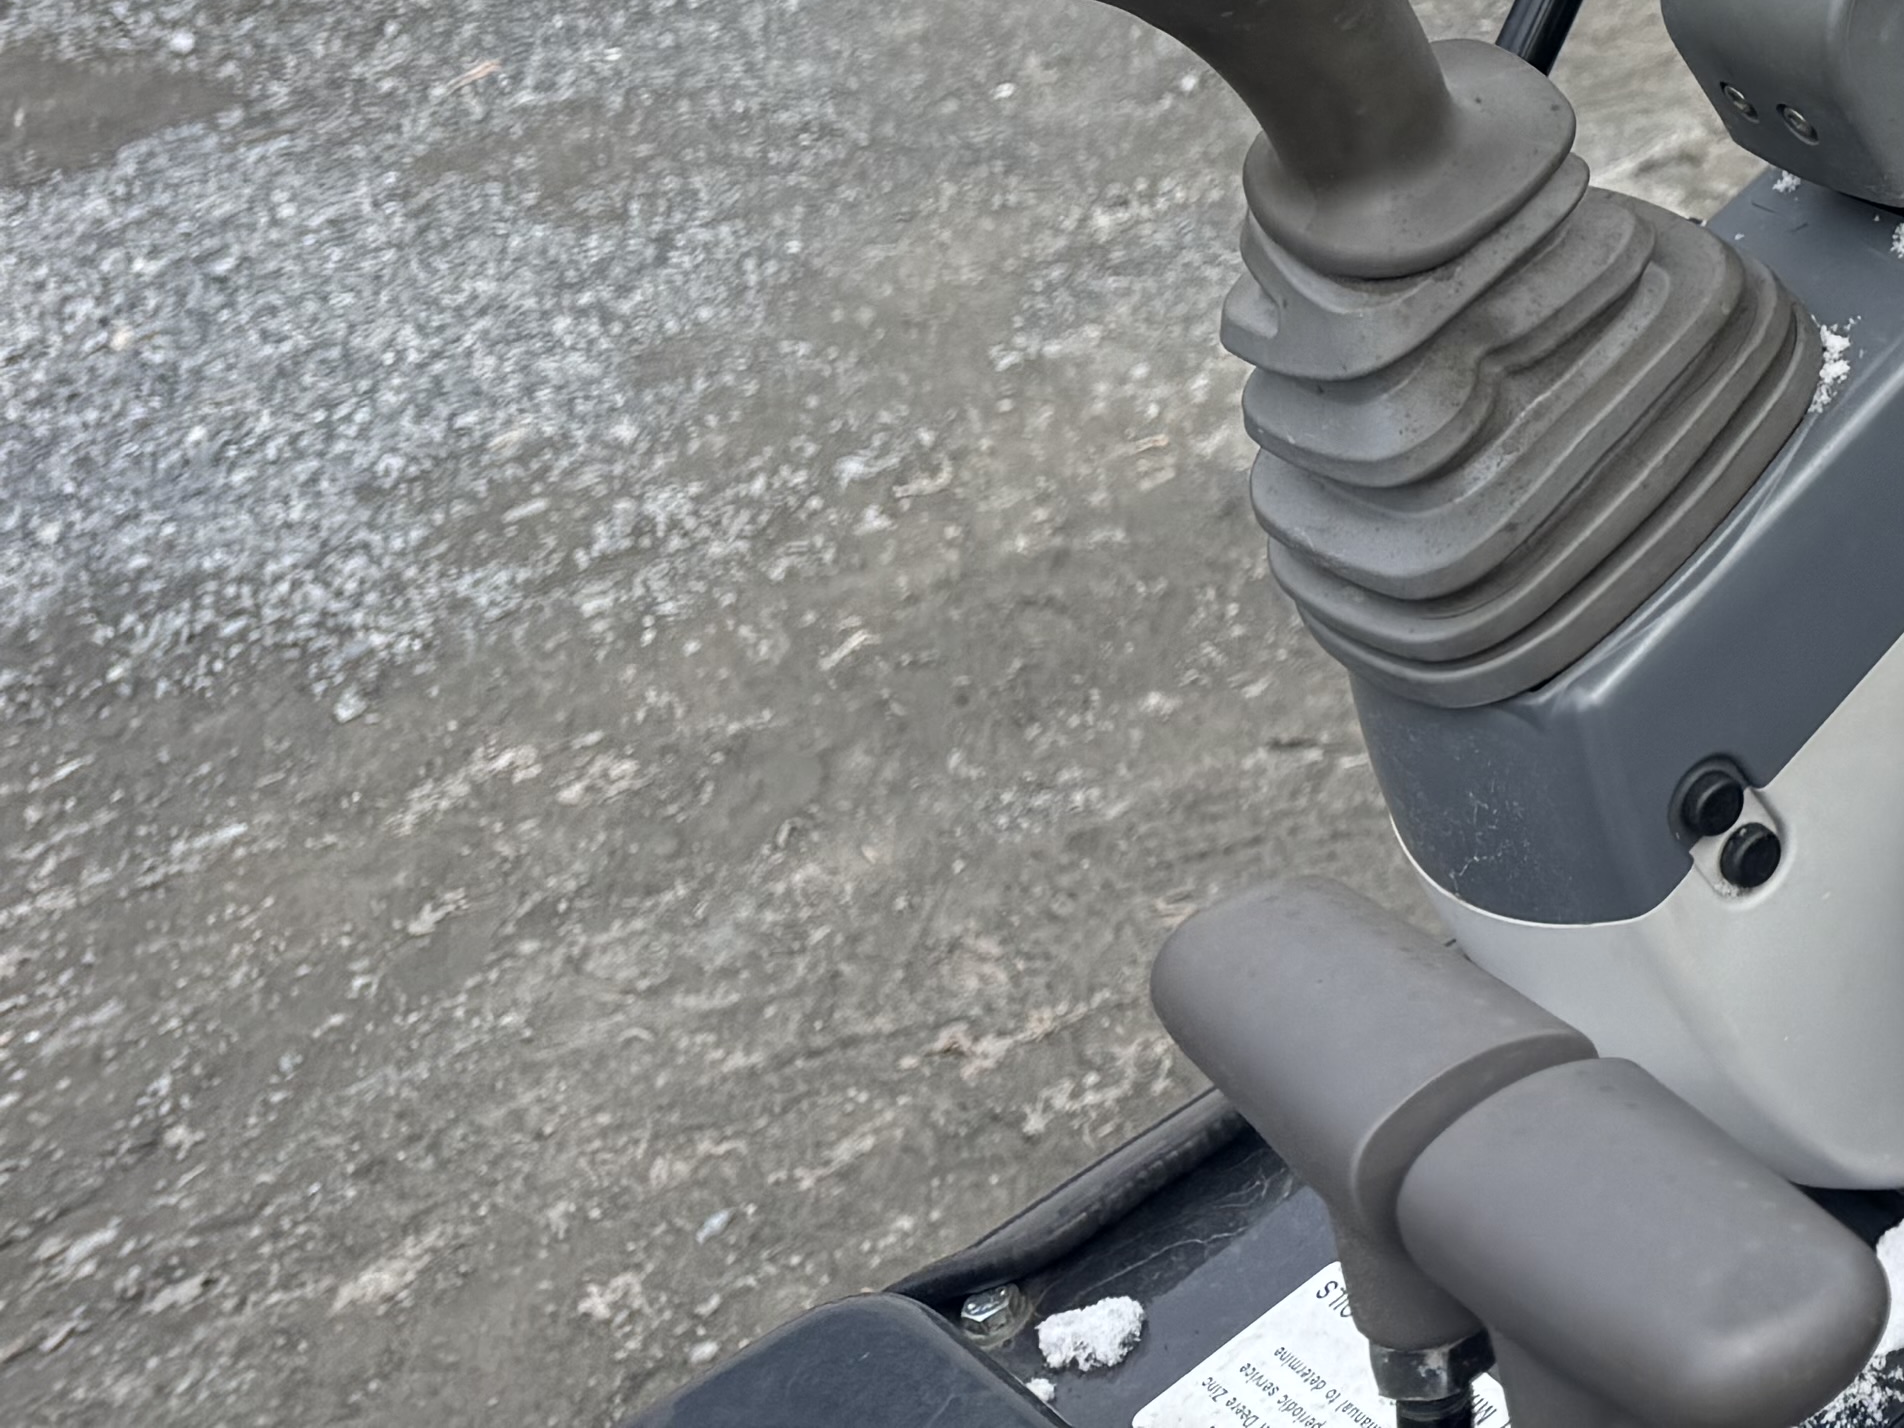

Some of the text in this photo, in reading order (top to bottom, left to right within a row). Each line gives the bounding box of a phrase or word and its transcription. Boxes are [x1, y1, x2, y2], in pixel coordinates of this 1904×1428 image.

[1240, 1362, 1279, 1396] service
[1274, 1346, 1326, 1393] determine
[1201, 1377, 1259, 1428] Deere Zinc
[1325, 1388, 1341, 1403] to
